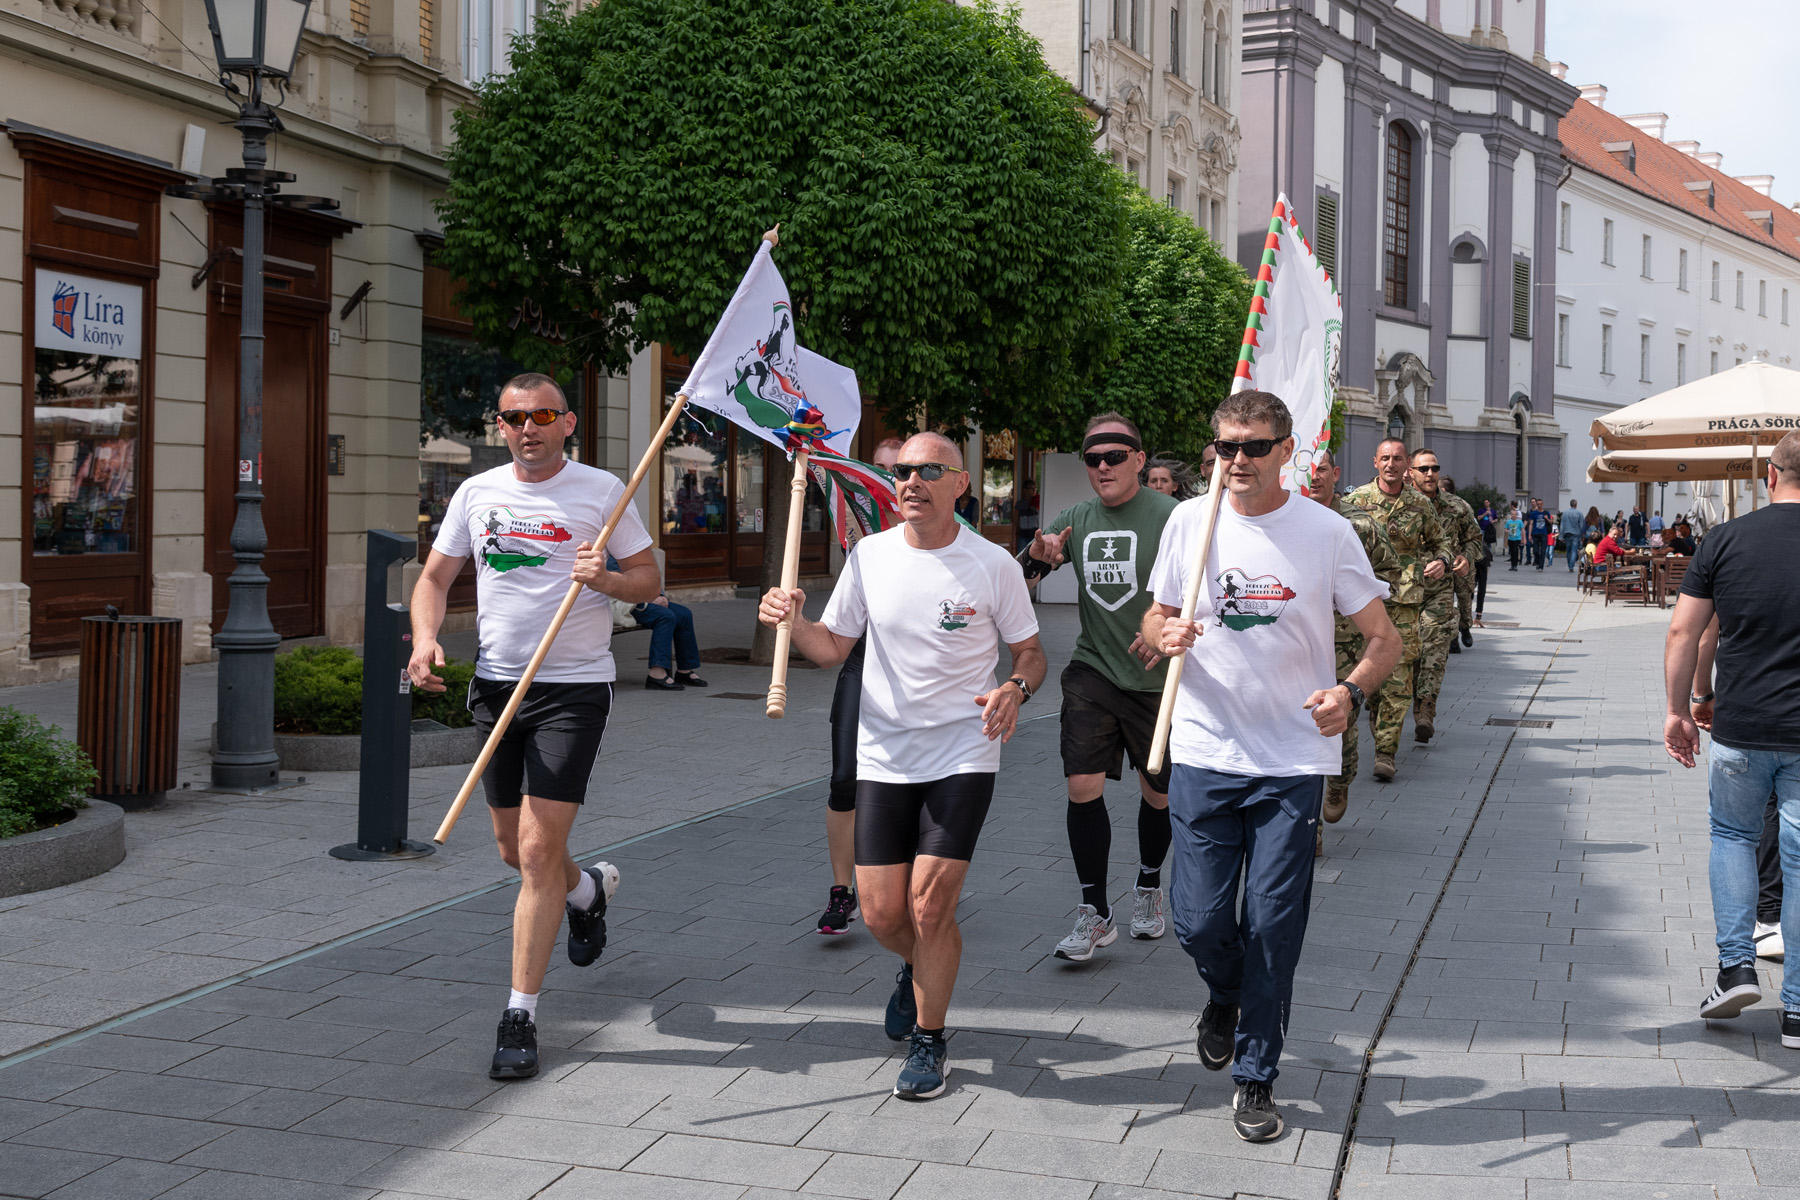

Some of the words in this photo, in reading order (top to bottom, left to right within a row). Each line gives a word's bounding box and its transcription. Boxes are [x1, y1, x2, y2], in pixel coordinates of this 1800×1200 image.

[83, 292, 124, 325] Líra
[83, 324, 124, 350] könyv
[1708, 417, 1761, 430] PRÁGA
[1097, 563, 1120, 571] ARMY
[1092, 571, 1126, 583] BOY
[1244, 600, 1268, 609] 2022
